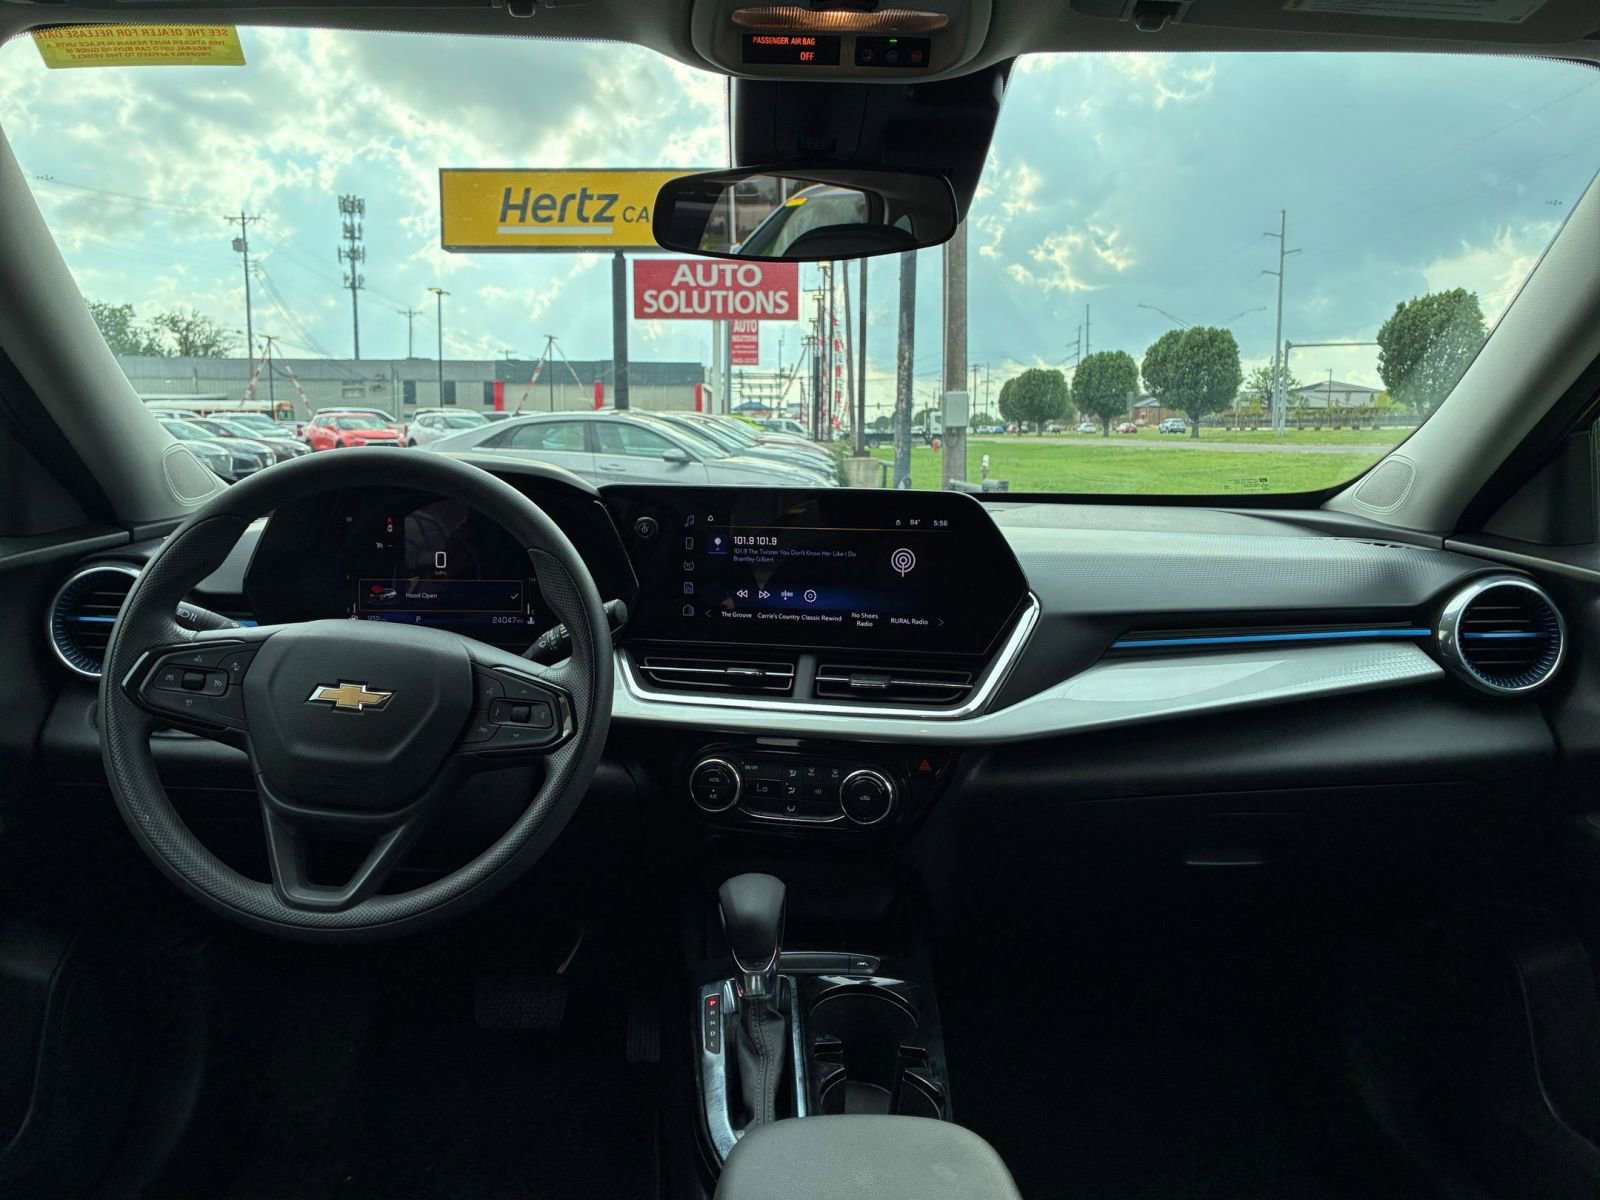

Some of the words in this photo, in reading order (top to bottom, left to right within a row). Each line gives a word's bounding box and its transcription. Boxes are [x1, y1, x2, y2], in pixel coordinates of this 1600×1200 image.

[752, 36, 789, 45] PASSENGER
[791, 37, 801, 46] AIR
[802, 37, 816, 46] BAG
[800, 51, 815, 61] OFF
[499, 187, 620, 224] Hertz
[671, 264, 763, 288] AUTO
[643, 290, 790, 315] SOLUTIONS
[733, 319, 757, 333] AUTO
[733, 536, 754, 545] 101.9
[756, 536, 778, 546] 101.9
[435, 551, 447, 569] 0
[757, 612, 778, 620] Carrie's
[890, 617, 911, 625] RURAL
[757, 782, 769, 793] Lo
